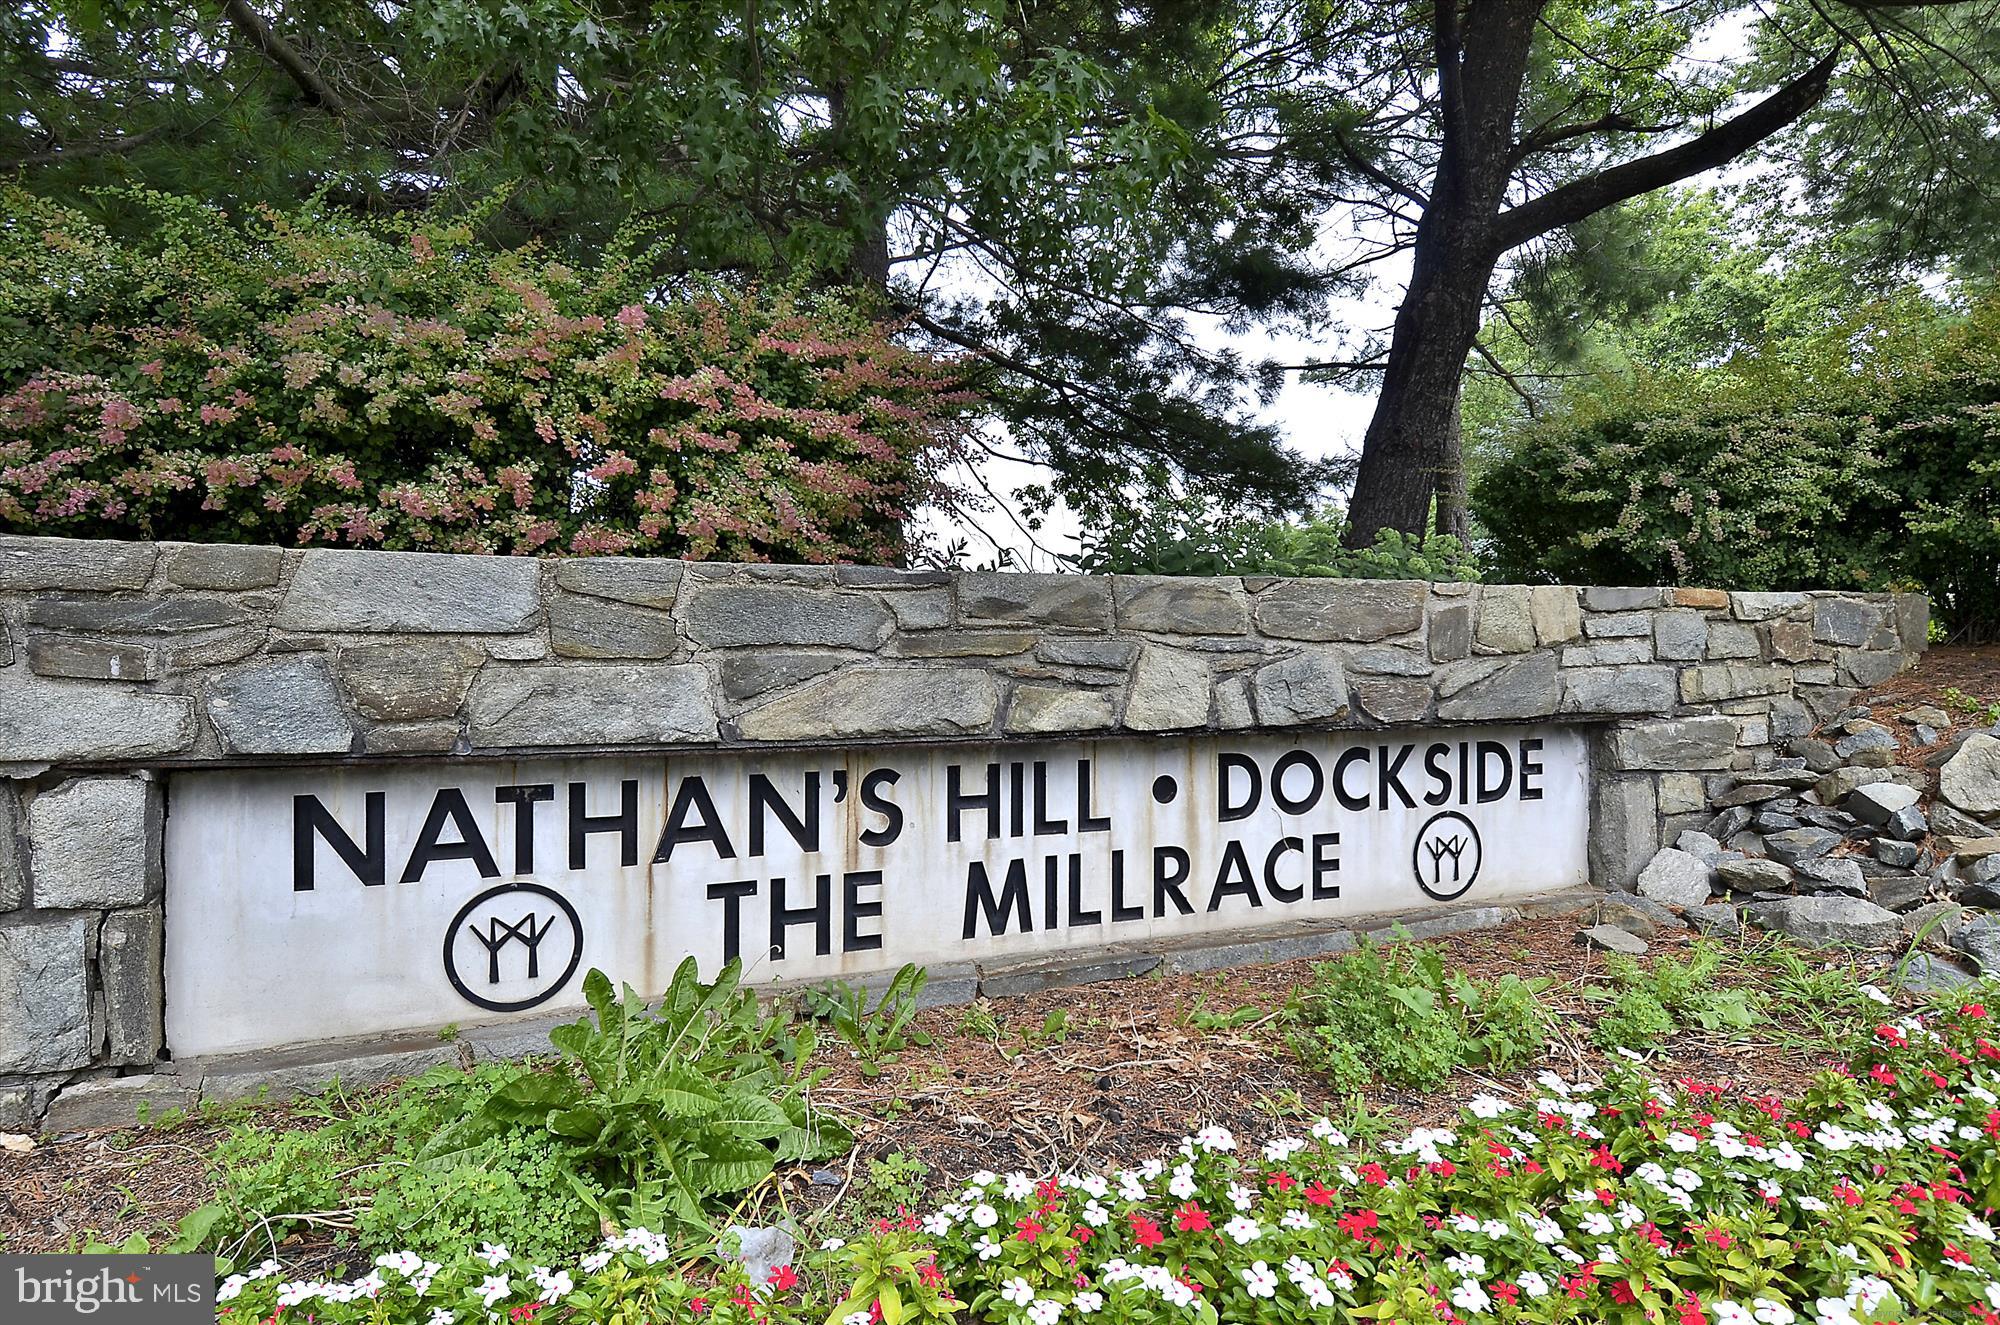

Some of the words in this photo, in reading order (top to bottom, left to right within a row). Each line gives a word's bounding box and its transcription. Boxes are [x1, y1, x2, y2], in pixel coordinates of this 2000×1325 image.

[293, 767, 904, 892] NATHAN'S
[946, 758, 1111, 843] HILL
[1217, 738, 1544, 823] DOCKSIDE
[706, 870, 884, 965] THE
[962, 831, 1340, 940] MILLRACE
